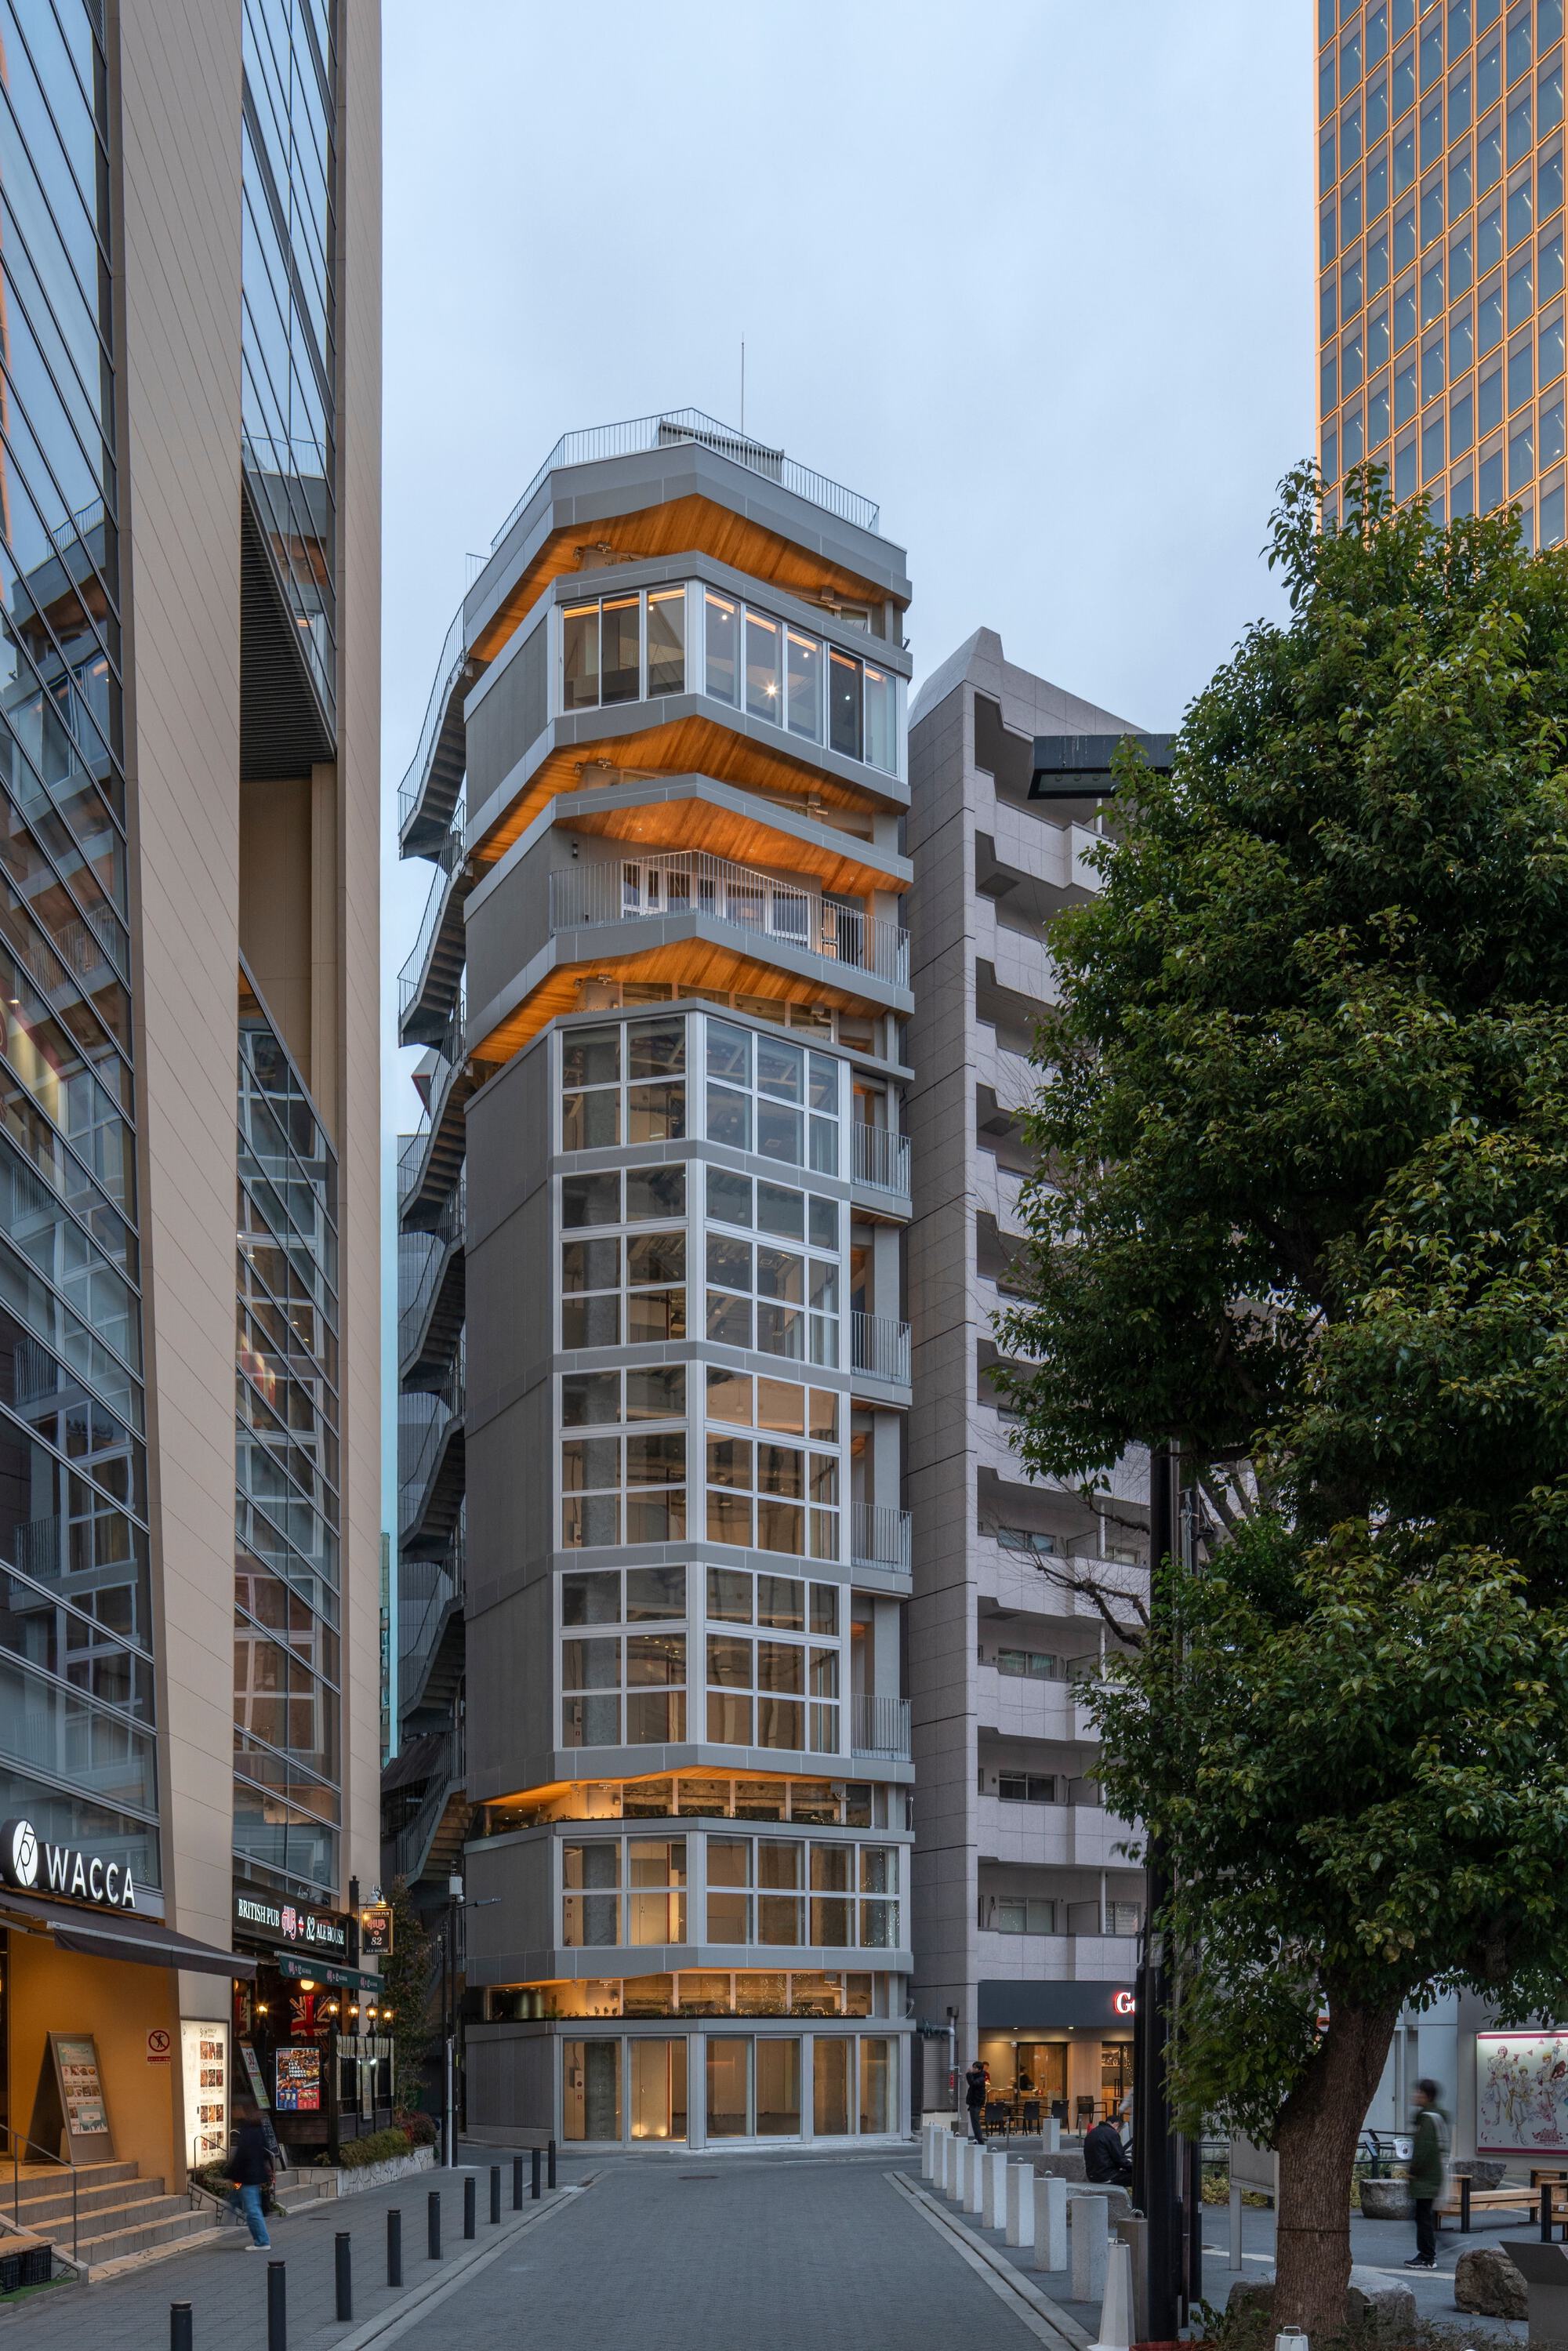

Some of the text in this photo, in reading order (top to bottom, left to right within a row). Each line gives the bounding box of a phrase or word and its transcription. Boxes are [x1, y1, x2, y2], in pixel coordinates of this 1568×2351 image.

[45, 1843, 136, 1908] WACCA
[238, 1899, 345, 1945] BRITISH PUB HUB 82 ALE HOUSE
[371, 1936, 383, 1946] 82
